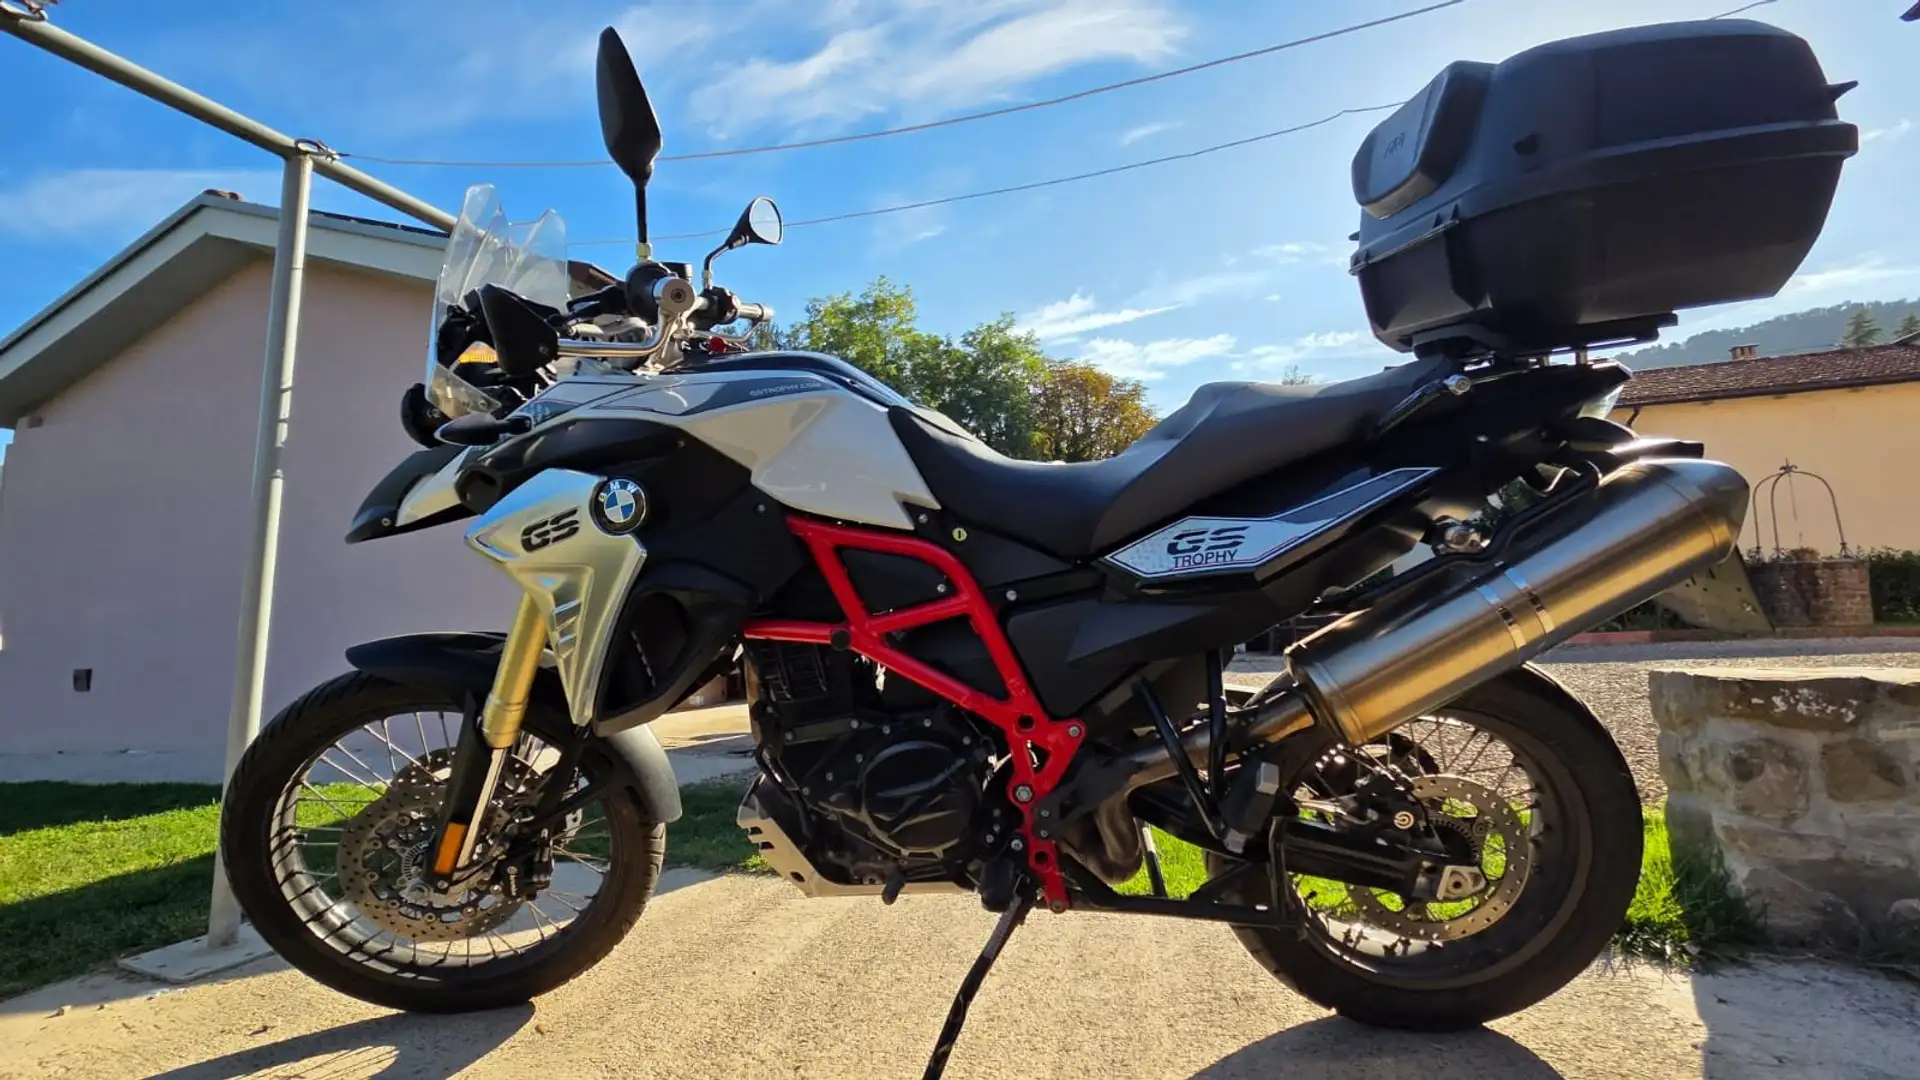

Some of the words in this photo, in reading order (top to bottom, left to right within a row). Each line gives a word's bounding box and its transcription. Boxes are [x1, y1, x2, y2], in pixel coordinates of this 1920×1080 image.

[598, 481, 639, 503] BMW
[521, 507, 580, 553] GS
[1167, 525, 1250, 555] GS
[1172, 548, 1238, 568] TROPHY
